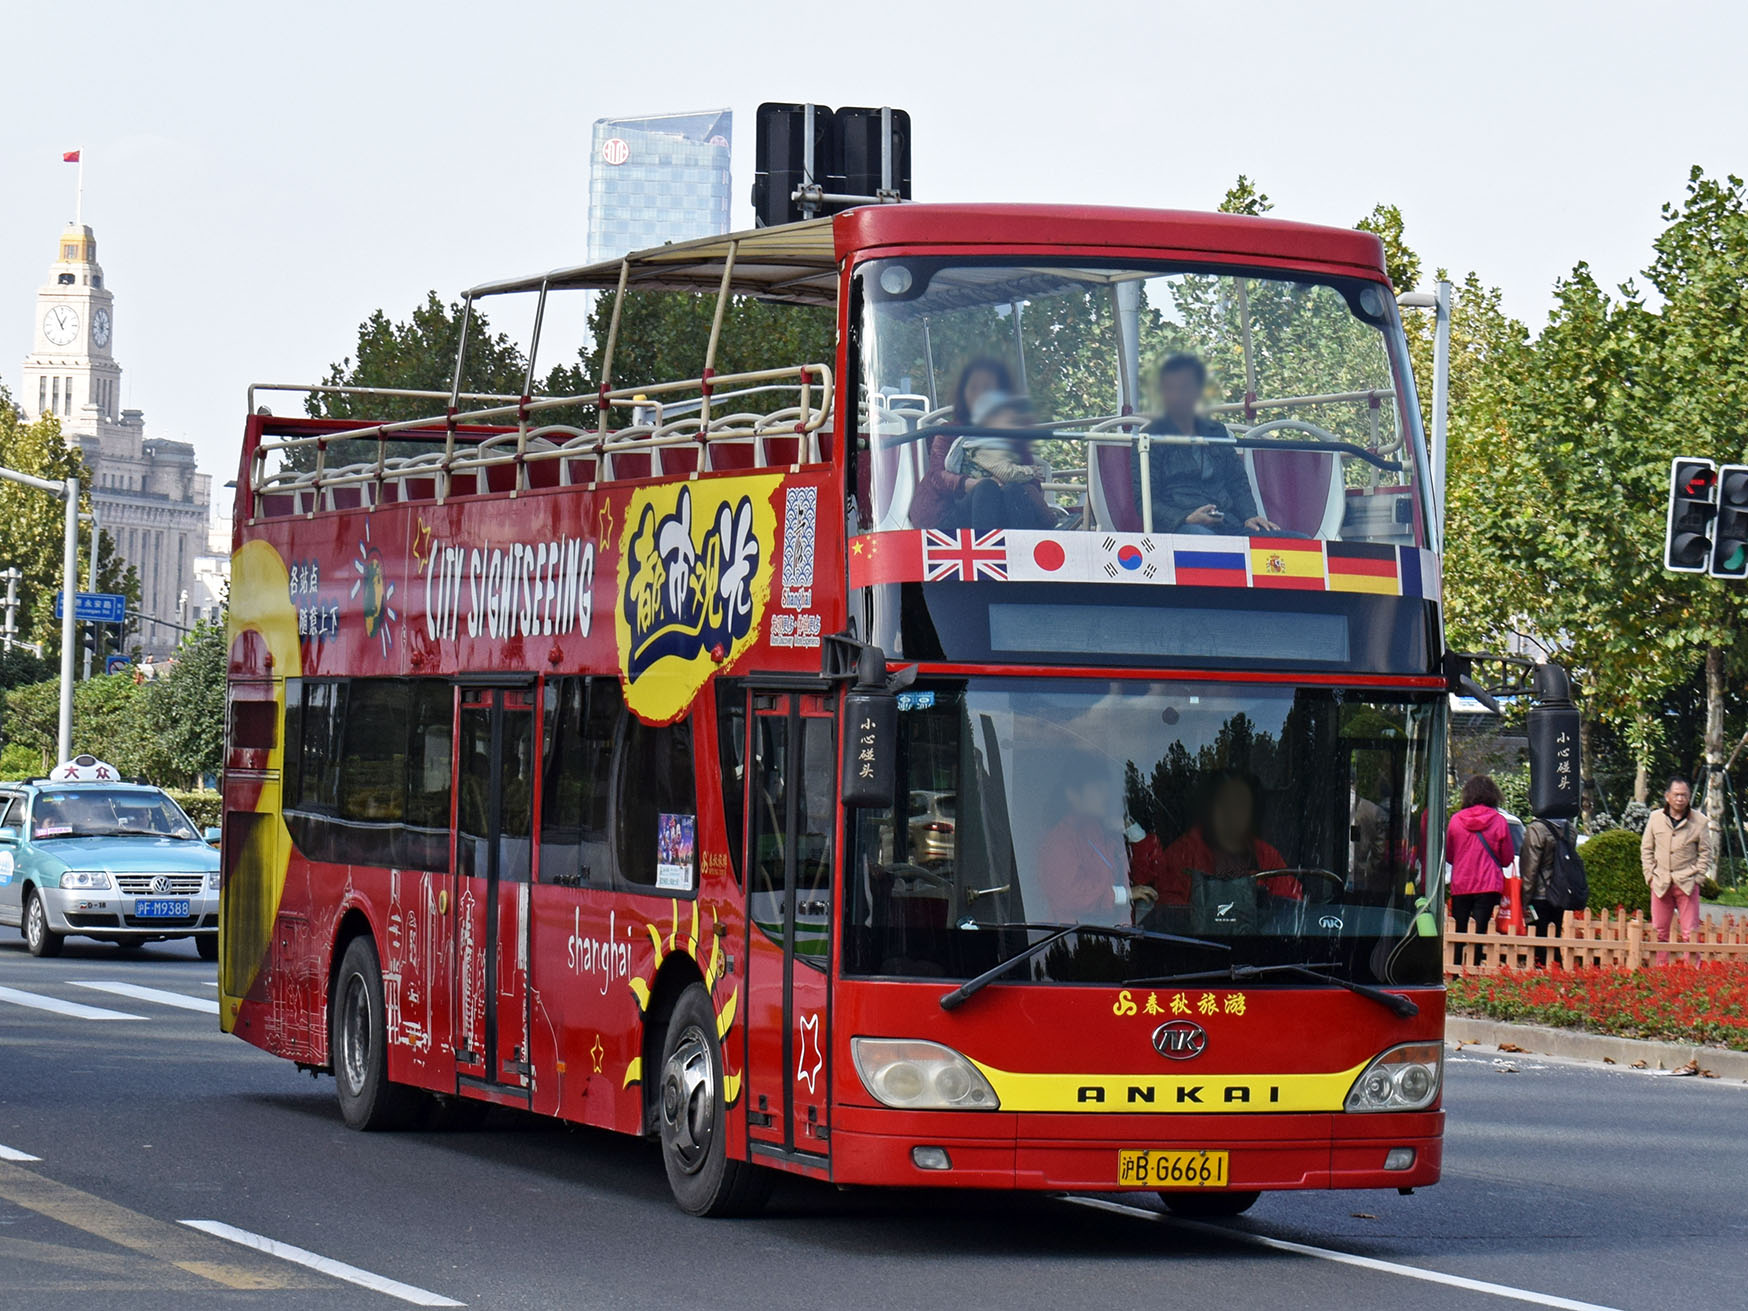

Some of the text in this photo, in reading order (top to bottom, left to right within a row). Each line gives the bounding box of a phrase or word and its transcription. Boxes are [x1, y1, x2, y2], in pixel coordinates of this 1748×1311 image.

[289, 564, 319, 598] 各站点
[426, 533, 593, 642] CITY SIGHTSEEING
[629, 490, 759, 660] 都市观光
[782, 588, 812, 610] Shanghai
[298, 605, 339, 637] 随意上下
[858, 717, 876, 778] 小心碰头
[1556, 731, 1571, 790] 小心碰头
[64, 766, 111, 780] 大众
[567, 906, 632, 996] shanghai
[1142, 991, 1246, 1016] 春秋旅游
[1077, 1086, 1279, 1103] ANKAI
